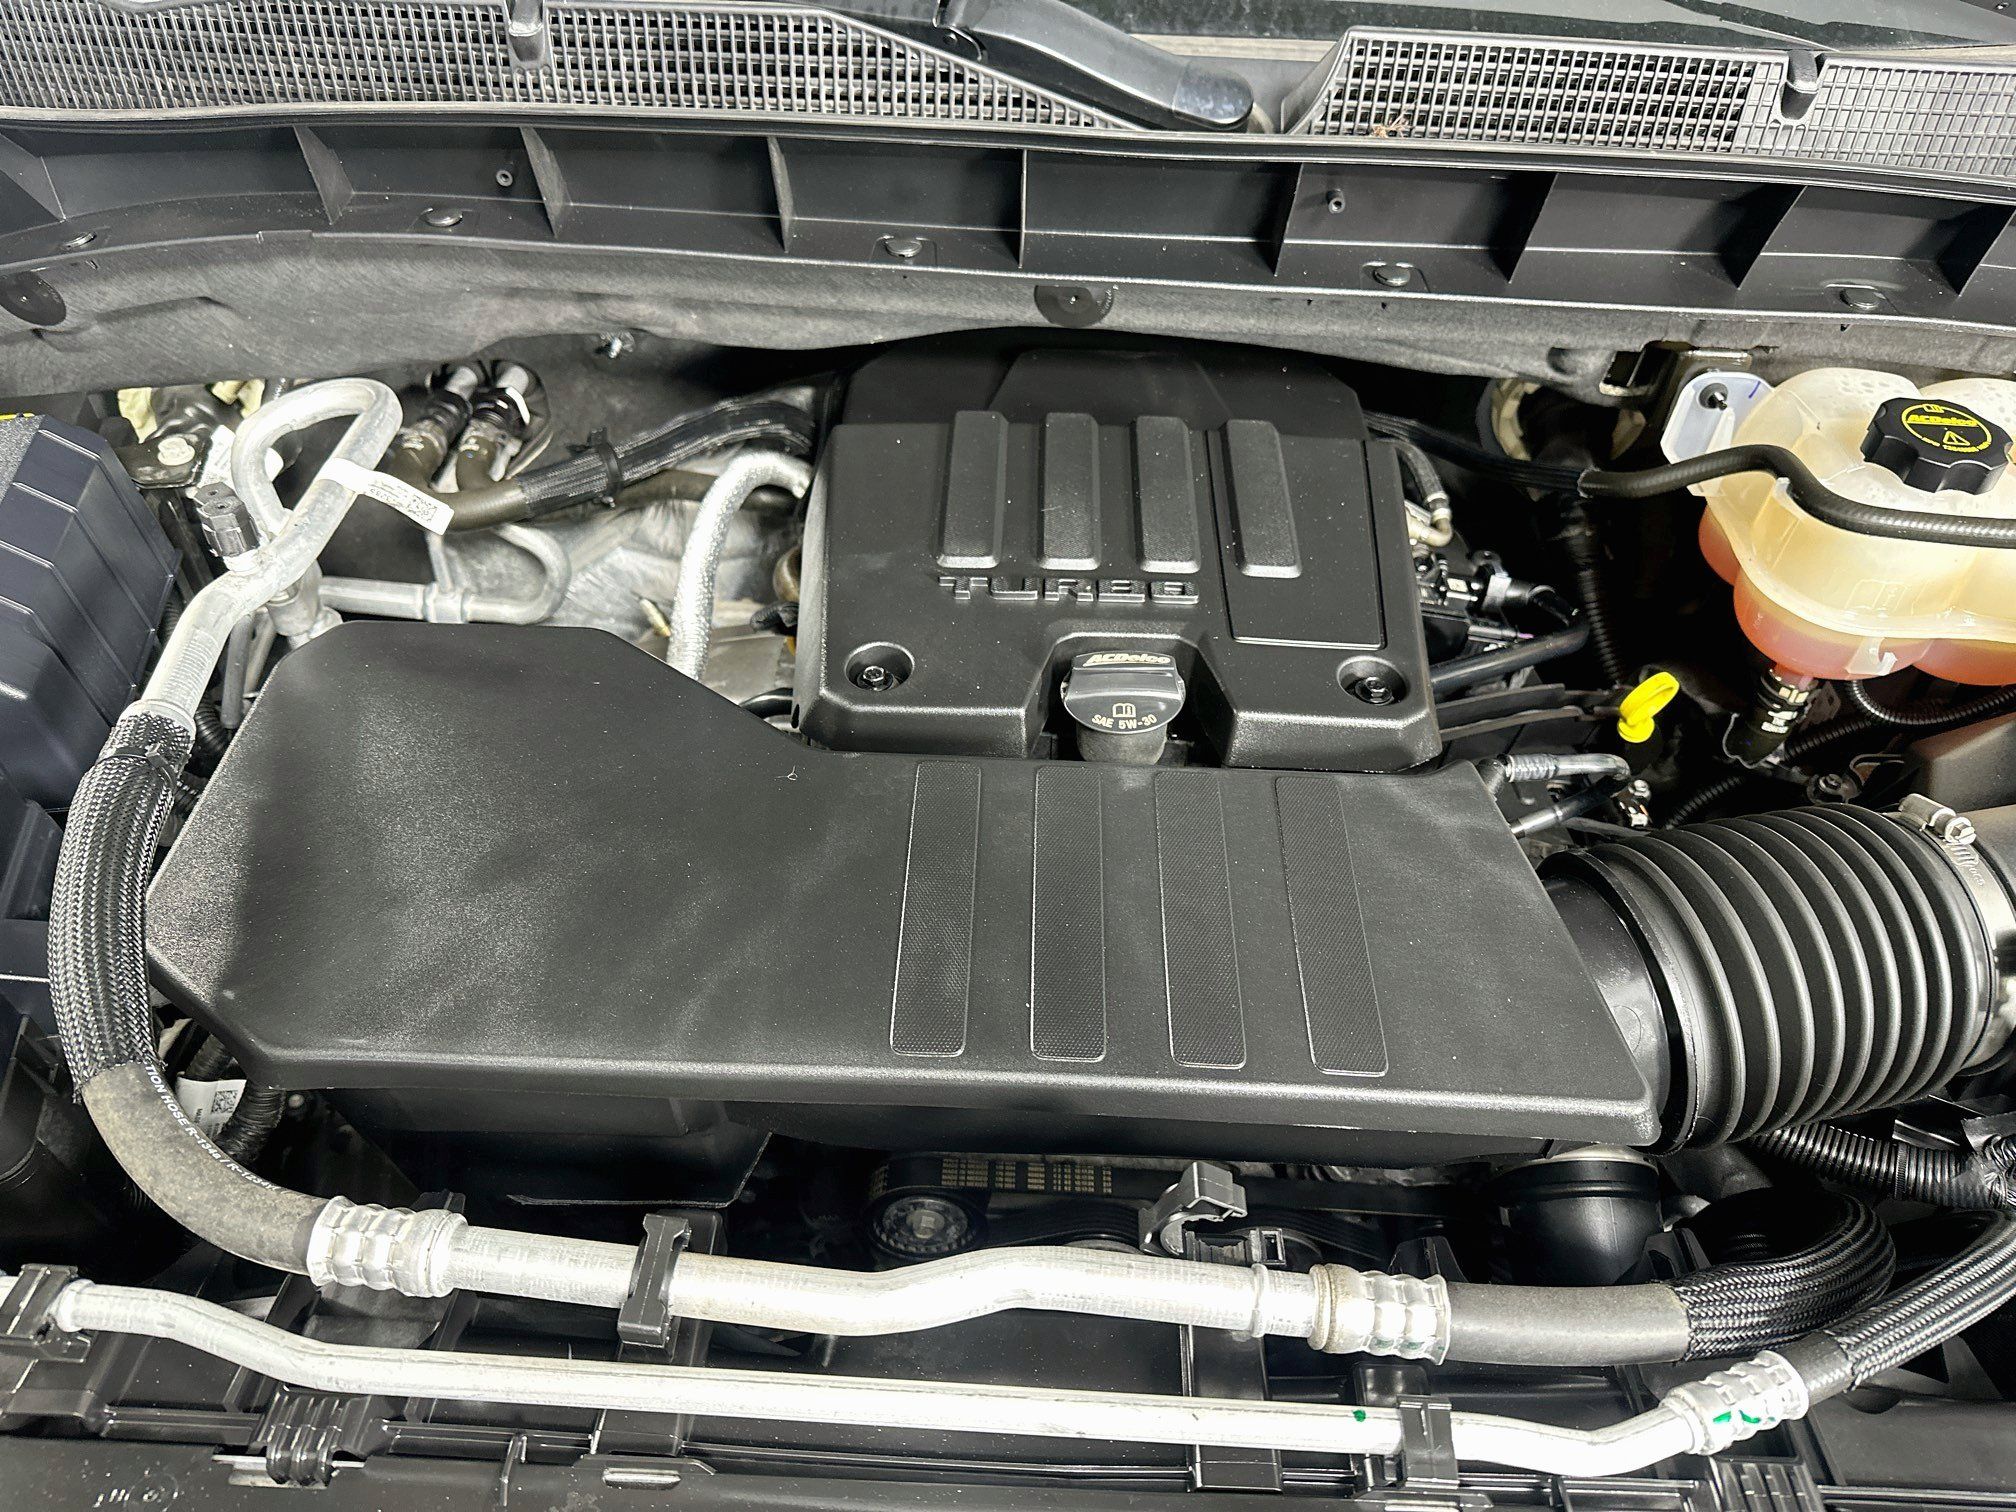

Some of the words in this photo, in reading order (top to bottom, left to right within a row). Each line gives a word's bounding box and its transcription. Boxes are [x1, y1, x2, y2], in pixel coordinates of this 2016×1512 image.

[938, 577, 1199, 604] TURBO
[1083, 653, 1171, 667] ACDelco
[1091, 714, 1114, 728] SAE
[1118, 713, 1158, 729] 5W-30
[145, 1064, 167, 1093] TION
[160, 1095, 190, 1126] HOSE
[185, 1127, 221, 1159] R-134a
